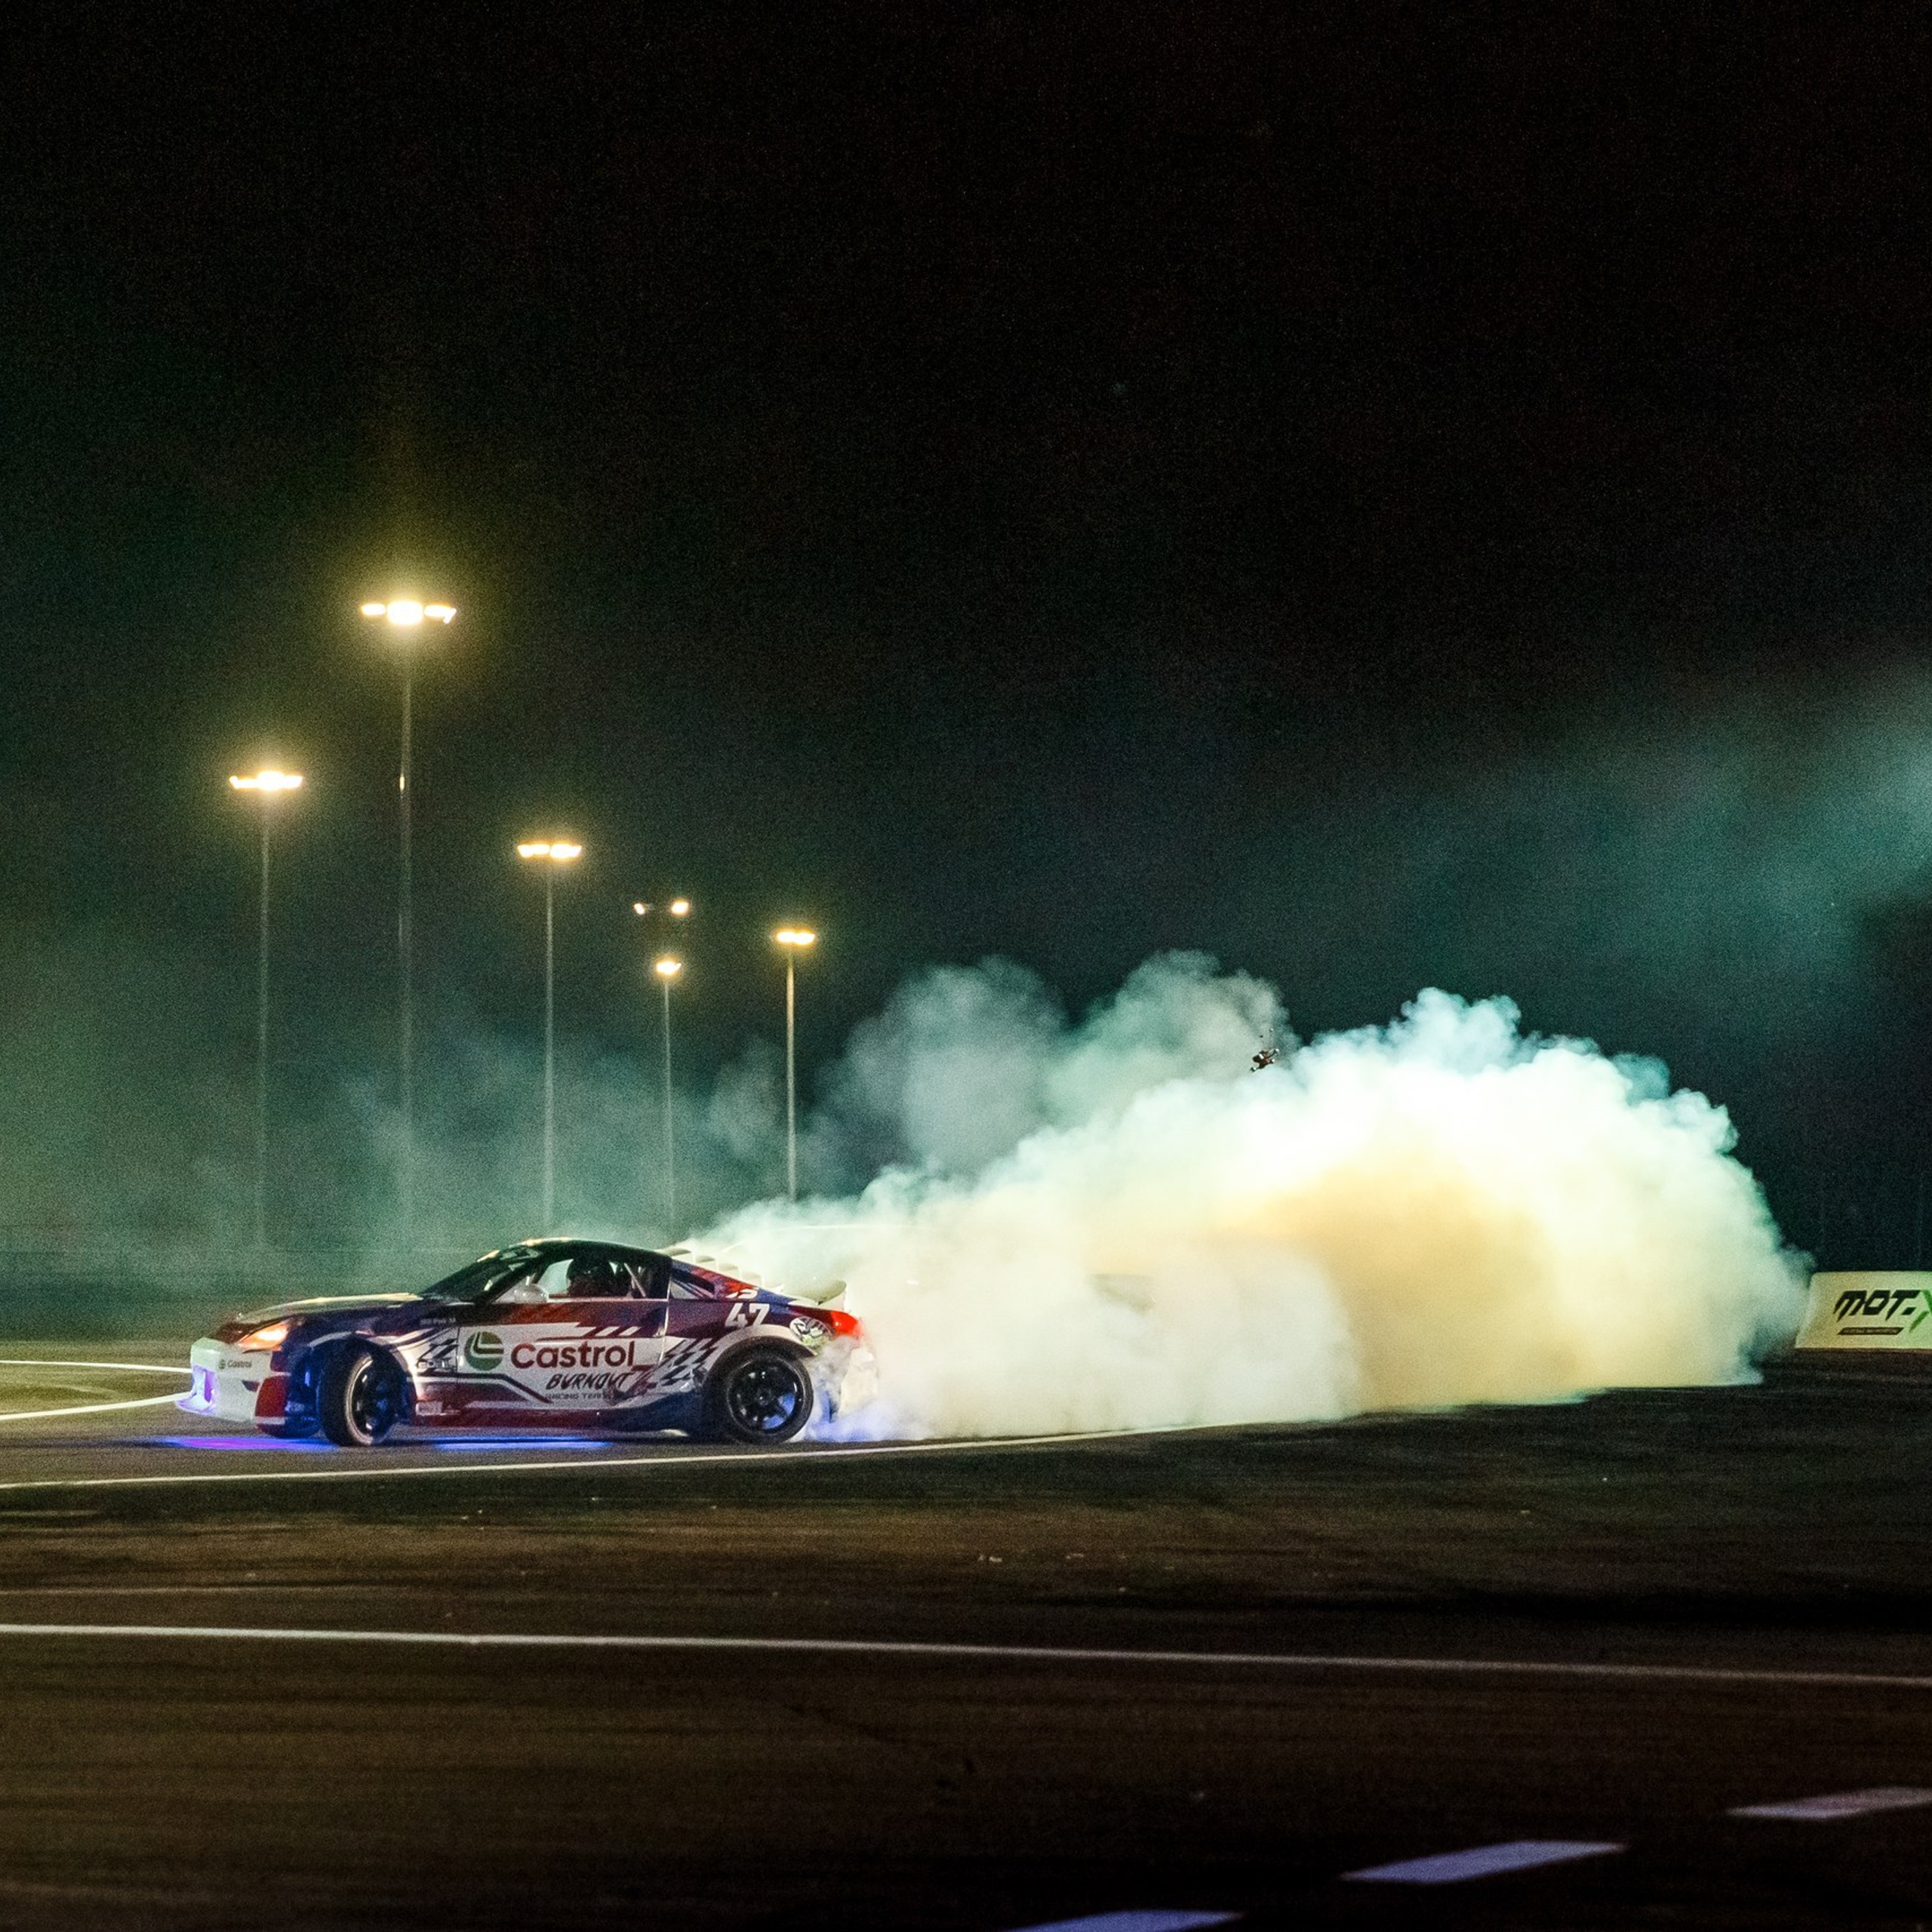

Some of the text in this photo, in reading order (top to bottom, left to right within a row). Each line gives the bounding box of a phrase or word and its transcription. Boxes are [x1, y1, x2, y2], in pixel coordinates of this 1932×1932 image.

[724, 1303, 771, 1327] 47
[510, 1340, 635, 1369] Castrol
[546, 1372, 636, 1390] BURNOUT
